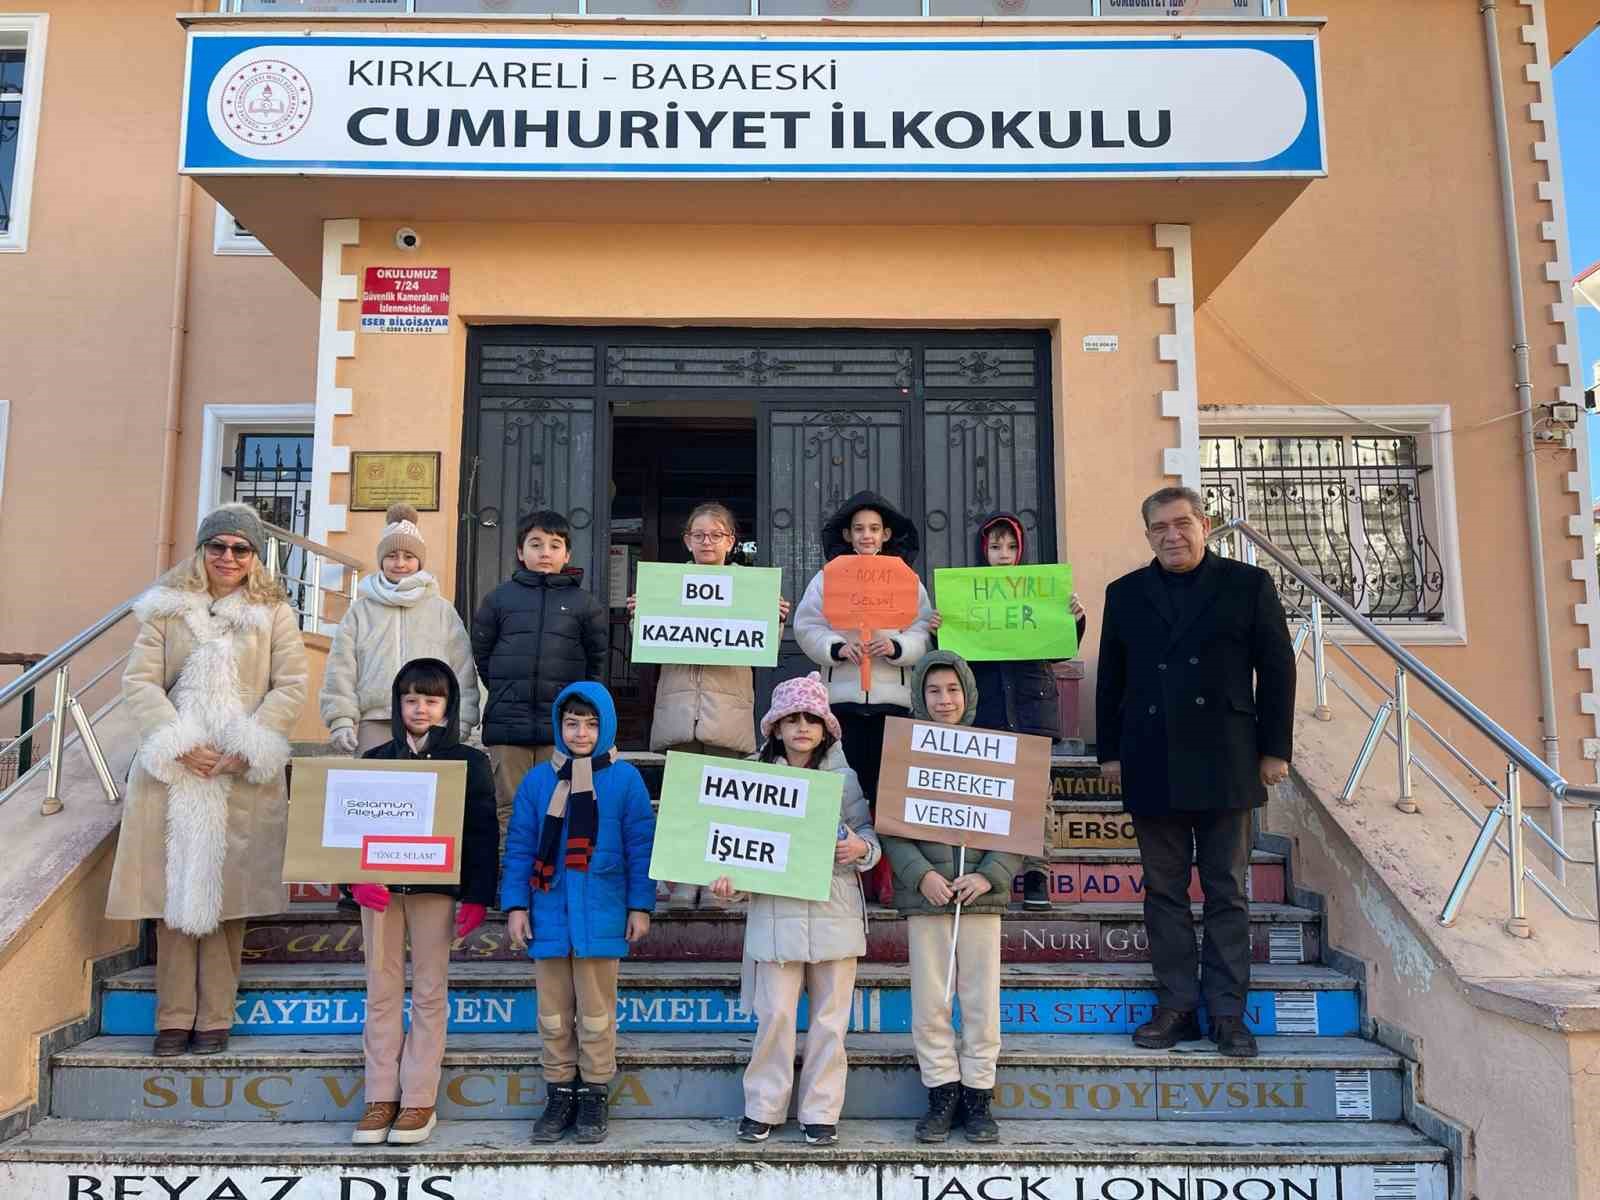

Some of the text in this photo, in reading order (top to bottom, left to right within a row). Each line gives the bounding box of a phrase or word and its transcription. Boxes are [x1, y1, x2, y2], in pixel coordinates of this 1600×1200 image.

[348, 58, 589, 89] KIRKLARELİ
[632, 58, 837, 91] BABAESKİ
[347, 101, 811, 149] CUMHURİYET
[831, 101, 1172, 150] İLKOKULU
[377, 268, 438, 279] OKULUMUZ
[395, 281, 419, 290] 7/24
[362, 316, 448, 326] ESER BİLGİSAYAR
[686, 583, 724, 601] BOL
[974, 576, 1055, 600] HAYIRLI
[642, 624, 764, 648] KAZANÇLAR
[920, 729, 1001, 759] ALLAH
[705, 776, 798, 808] HAYIRLI
[918, 770, 1006, 797] BEREKET
[915, 804, 987, 830] VERSİN
[1069, 821, 1137, 840] ERSO
[711, 830, 775, 864] İŞLER
[143, 1075, 295, 1122] SUÇ
[992, 1075, 1309, 1111] OSTOYEVSKİ
[913, 1176, 1318, 1200] JACK LONDON
